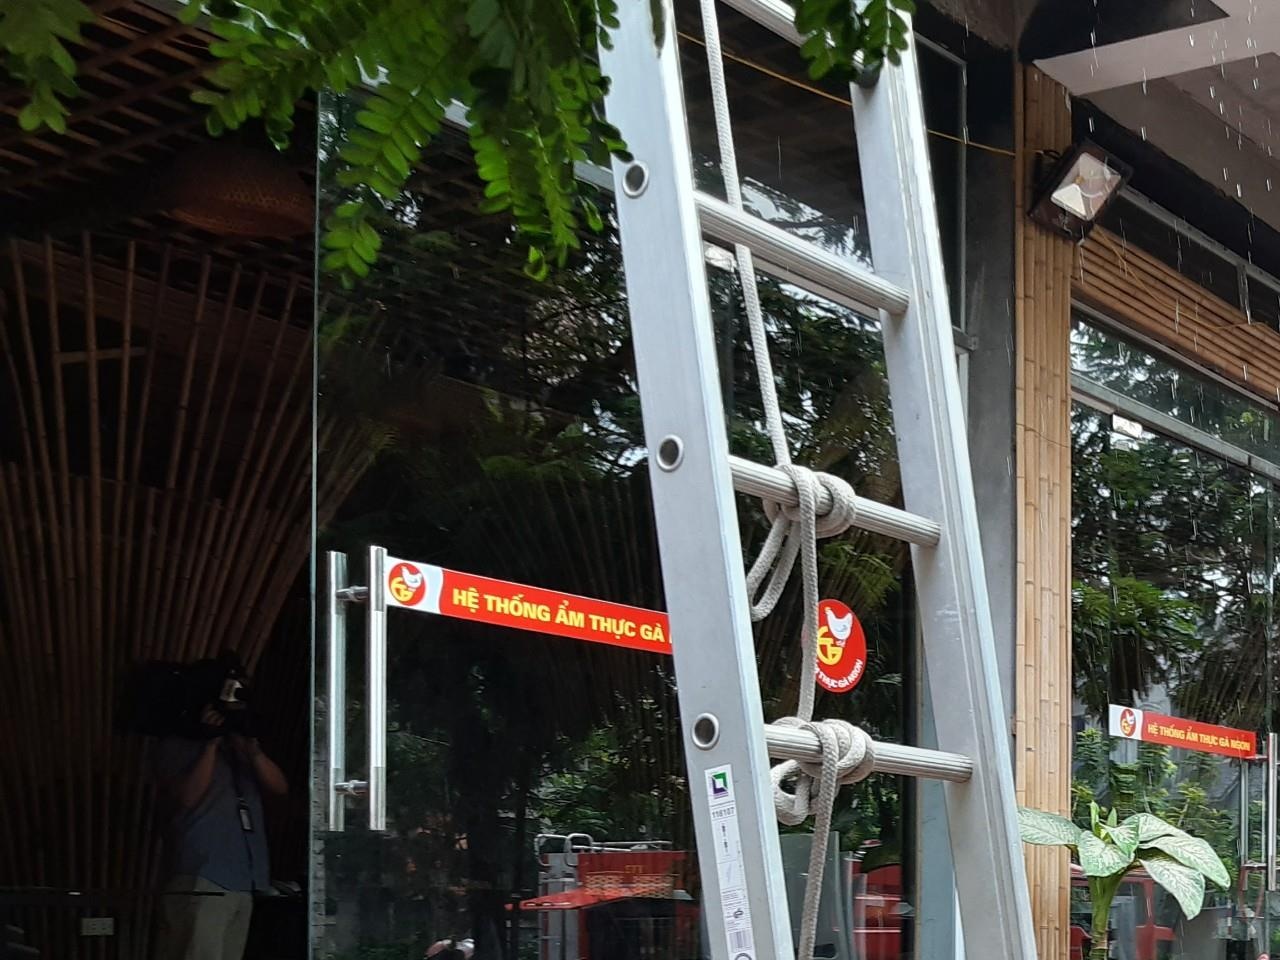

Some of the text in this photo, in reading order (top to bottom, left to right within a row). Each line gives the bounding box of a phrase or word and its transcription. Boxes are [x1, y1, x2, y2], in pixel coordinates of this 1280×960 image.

[453, 587, 479, 613] HỆ
[483, 593, 551, 622] THỐNG
[555, 600, 585, 629] ẨM
[589, 614, 636, 640] THỰC
[640, 622, 665, 643] GÀ
